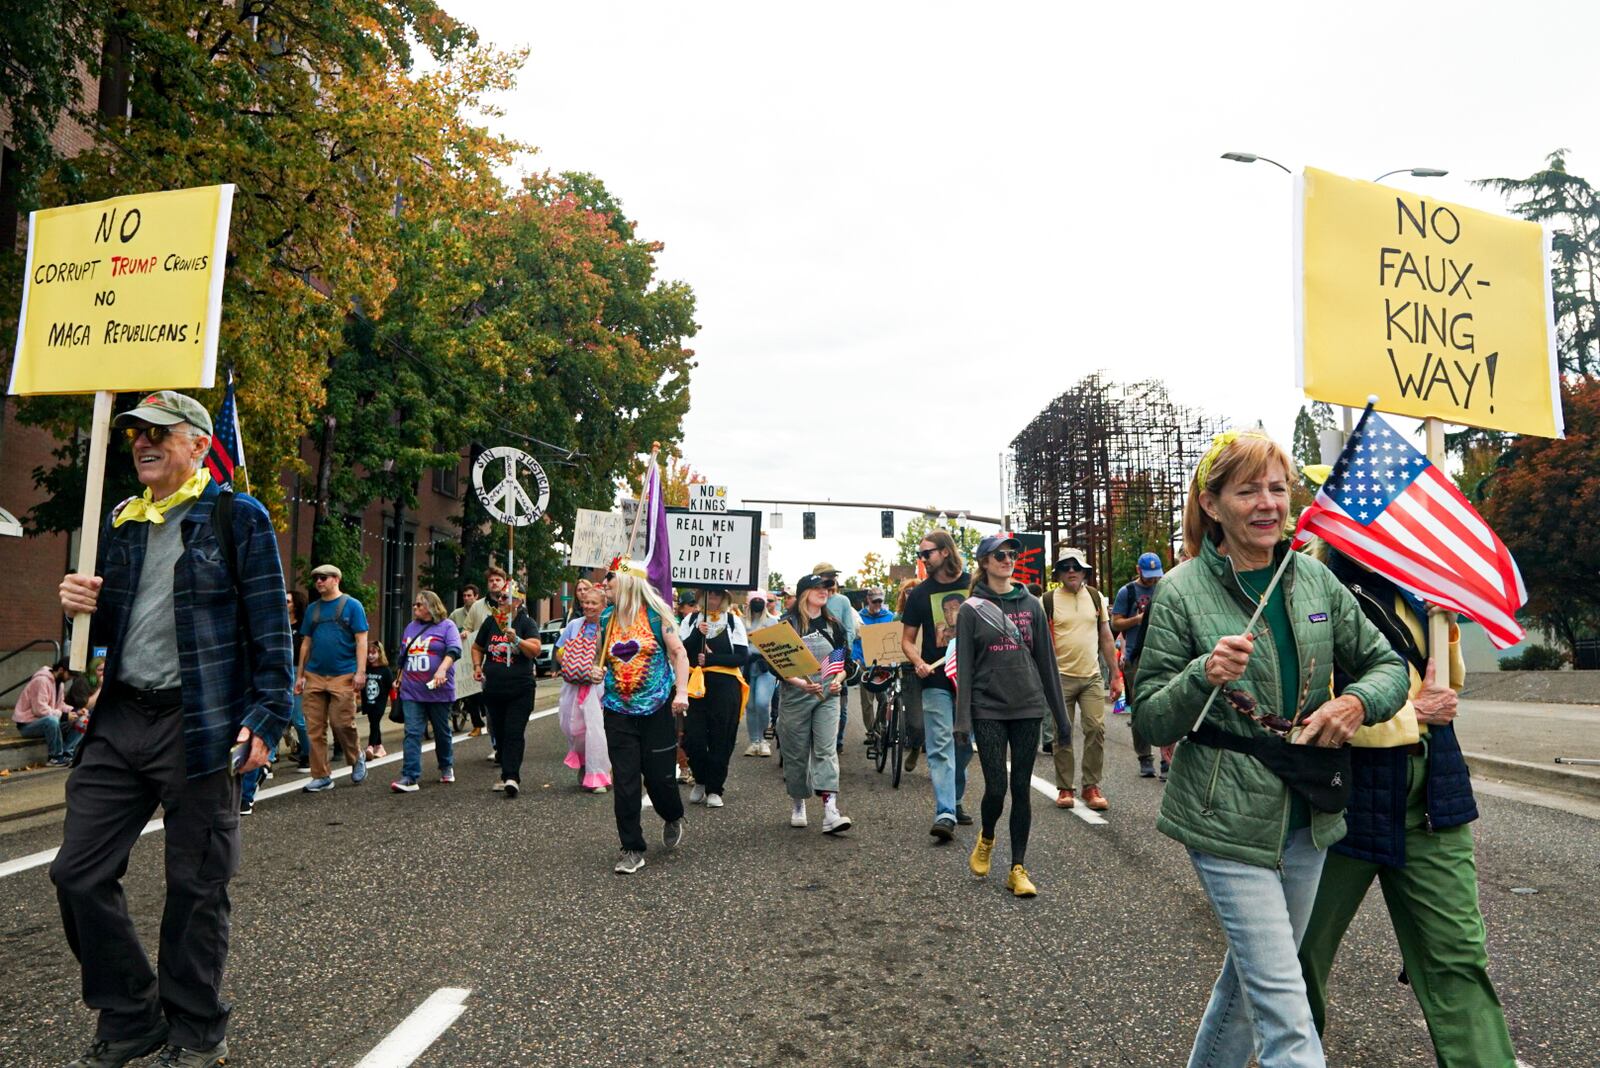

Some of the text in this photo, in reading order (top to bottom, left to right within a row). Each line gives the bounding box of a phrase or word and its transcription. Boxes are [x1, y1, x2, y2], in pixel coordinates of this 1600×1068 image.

[95, 208, 141, 243] NO
[1396, 197, 1460, 244] NO
[34, 254, 208, 284] CORRUPT TRUMP CRONIES
[1380, 247, 1490, 299] FAUX-
[94, 290, 115, 306] NO
[48, 322, 90, 348] MAGA
[1385, 298, 1475, 353] KING
[1387, 348, 1498, 414] WAY!
[477, 450, 496, 469] SIN
[518, 452, 549, 496] JUSTICIA
[700, 485, 714, 497] NO
[476, 486, 490, 507] NO
[500, 513, 518, 526] HAY
[691, 499, 726, 511] KINGS
[676, 518, 735, 532] REAL MEN
[691, 533, 722, 547] DON'T
[679, 549, 731, 564] ZIP TIE
[672, 566, 742, 583] CHILDREN!
[407, 655, 430, 672] NO
